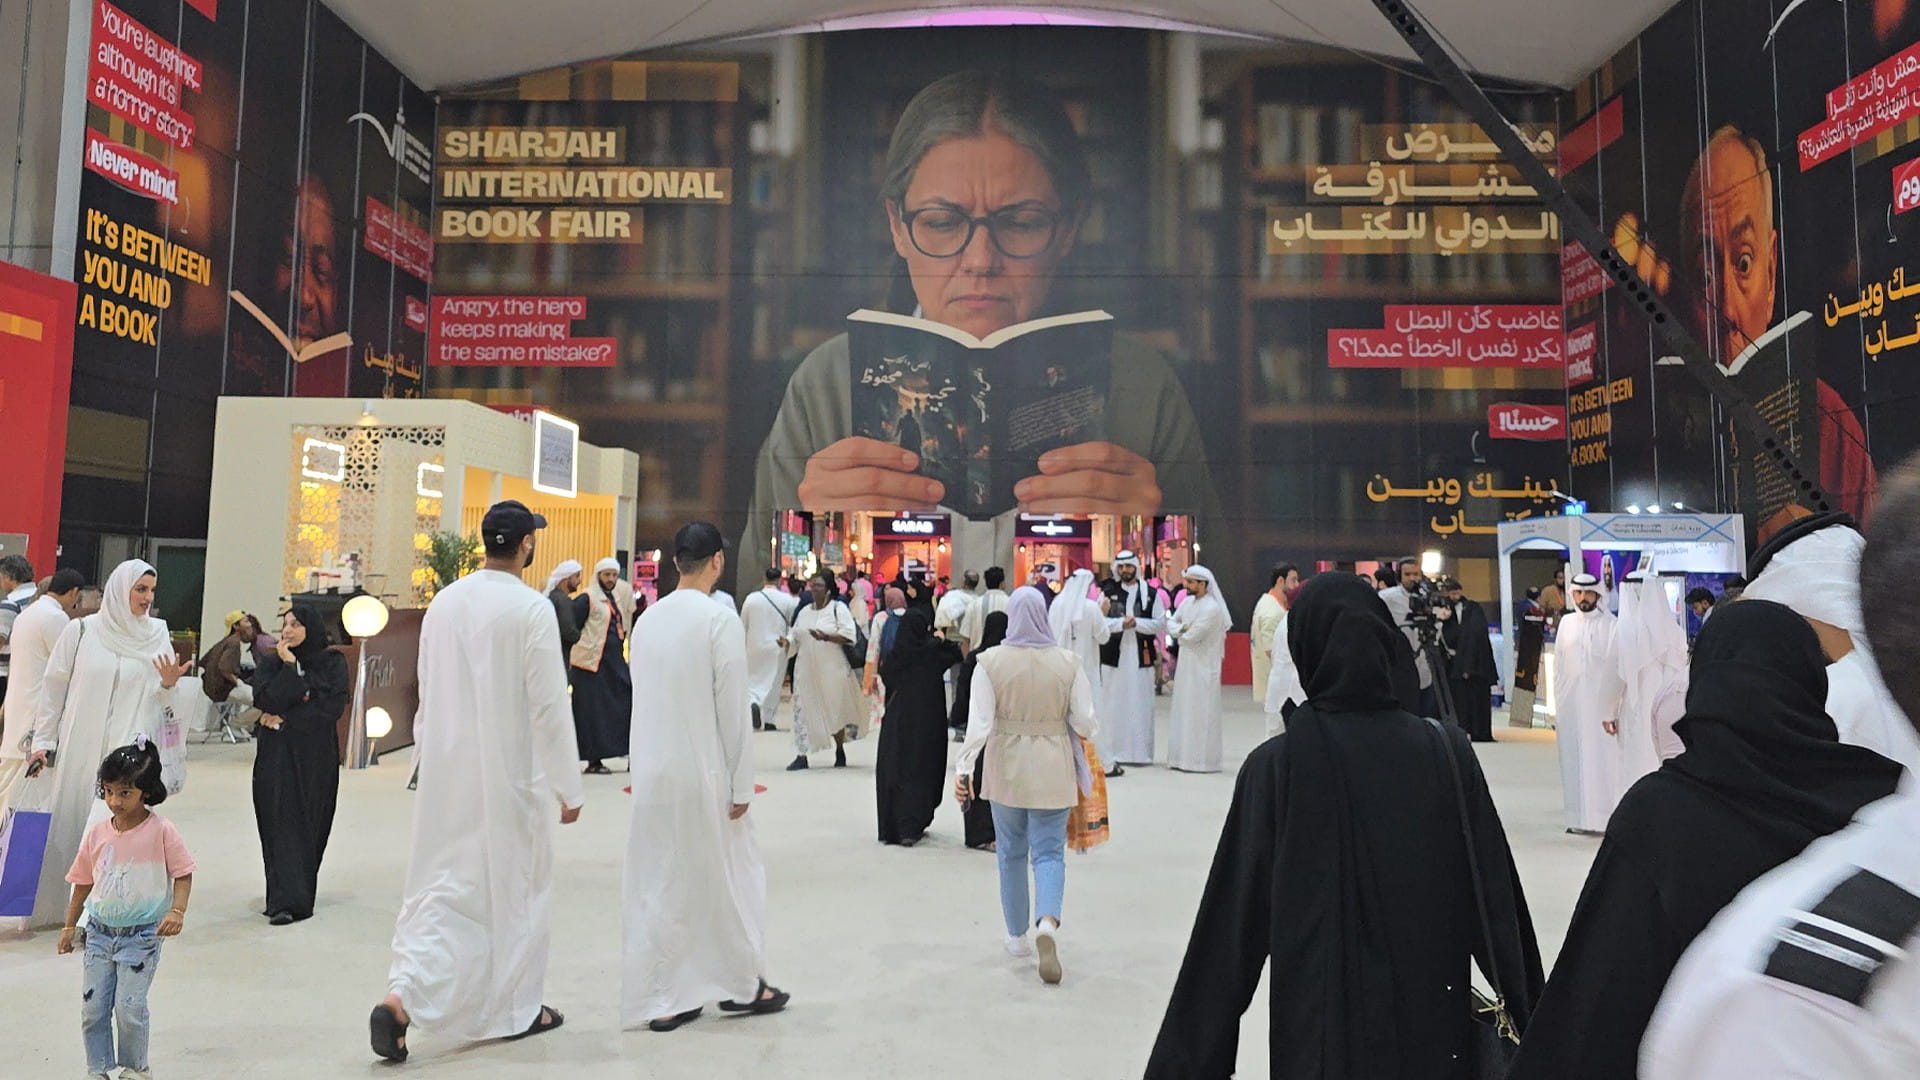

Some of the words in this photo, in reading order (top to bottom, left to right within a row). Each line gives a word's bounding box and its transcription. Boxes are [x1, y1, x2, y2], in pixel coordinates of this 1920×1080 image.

[101, 3, 144, 50] You're
[98, 42, 157, 94] although
[158, 75, 176, 105] it's
[95, 77, 107, 99] a
[107, 79, 156, 124] horror
[156, 110, 191, 148] story.
[444, 130, 617, 159] SHARJAH
[90, 139, 139, 182] Never
[443, 171, 725, 200] INTERNATIONAL
[441, 210, 542, 239] BOOK
[550, 210, 631, 239] FAIR
[1273, 210, 1426, 248] للكتاب
[1434, 211, 1559, 256] الدولي
[86, 207, 119, 250] It's
[122, 223, 211, 287] BETWEEN
[84, 249, 127, 295] YOU
[128, 268, 171, 310] AND
[79, 293, 96, 329] A
[100, 299, 158, 347] BOOK
[504, 299, 534, 315] the
[537, 299, 582, 316] hero
[1396, 310, 1452, 334] البطل
[1458, 306, 1493, 333] كأن
[1497, 310, 1560, 333] غاضب
[441, 321, 496, 339] keeps
[499, 321, 566, 340] making
[1567, 332, 1595, 357] Never
[440, 343, 471, 361] the
[474, 345, 525, 361] same
[528, 344, 612, 361] mistake?
[1407, 334, 1462, 357] الخطأ
[1467, 337, 1518, 362] نفس
[1522, 337, 1561, 363] يكرر
[1584, 376, 1633, 411] BETWEEN
[1570, 417, 1590, 441] YOU
[1590, 412, 1612, 437] AND
[1571, 447, 1579, 468] A
[1579, 440, 1608, 466] BOOK
[1366, 473, 1462, 505] وبين
[1468, 473, 1559, 503] بينك
